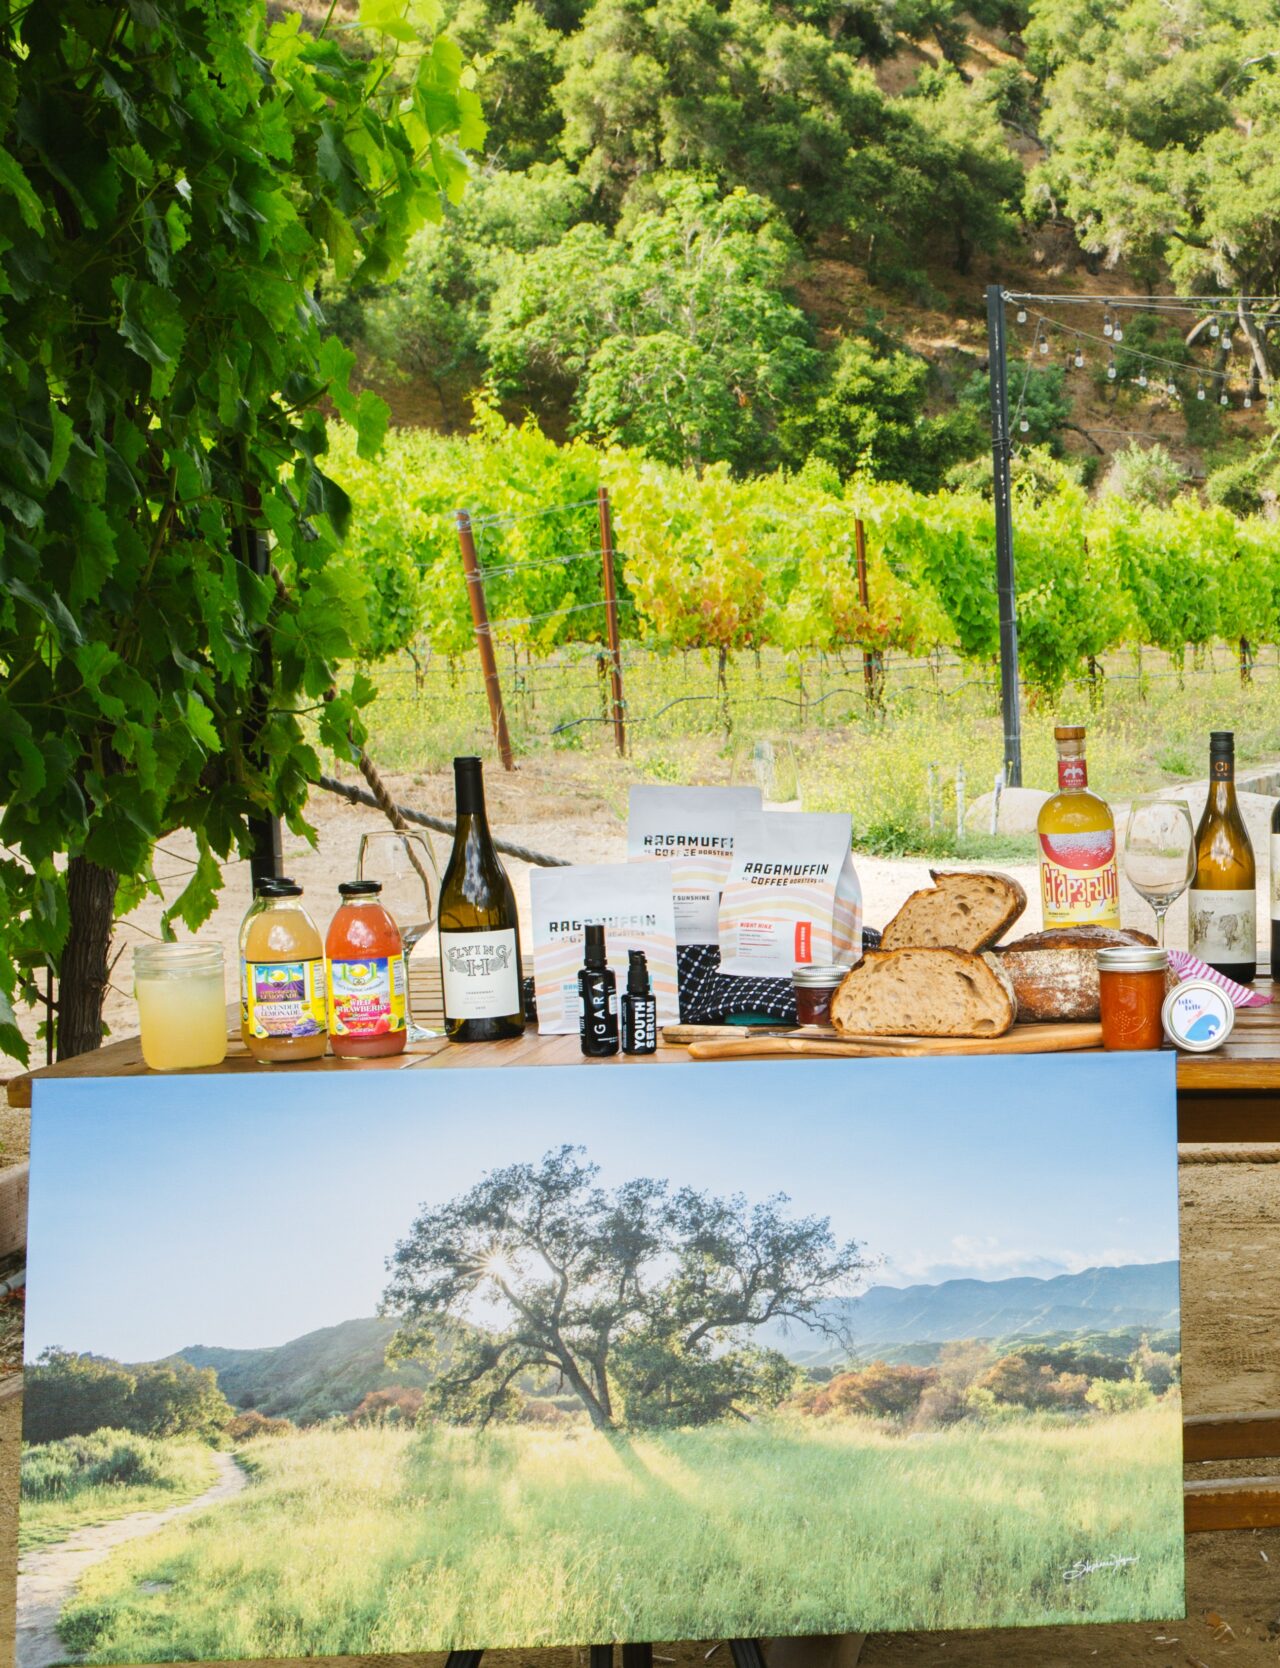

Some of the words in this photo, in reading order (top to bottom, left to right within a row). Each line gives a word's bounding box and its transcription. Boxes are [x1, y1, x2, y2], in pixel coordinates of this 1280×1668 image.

[743, 863, 829, 875] RAGAMUFFIN
[751, 876, 788, 886] COFFEE
[447, 945, 509, 967] FLYING
[467, 958, 490, 977] H
[261, 1003, 300, 1011] LAVENDER
[593, 982, 607, 1035] GARA
[634, 1001, 646, 1050] YOUTH
[646, 1001, 655, 1048] SERUM
